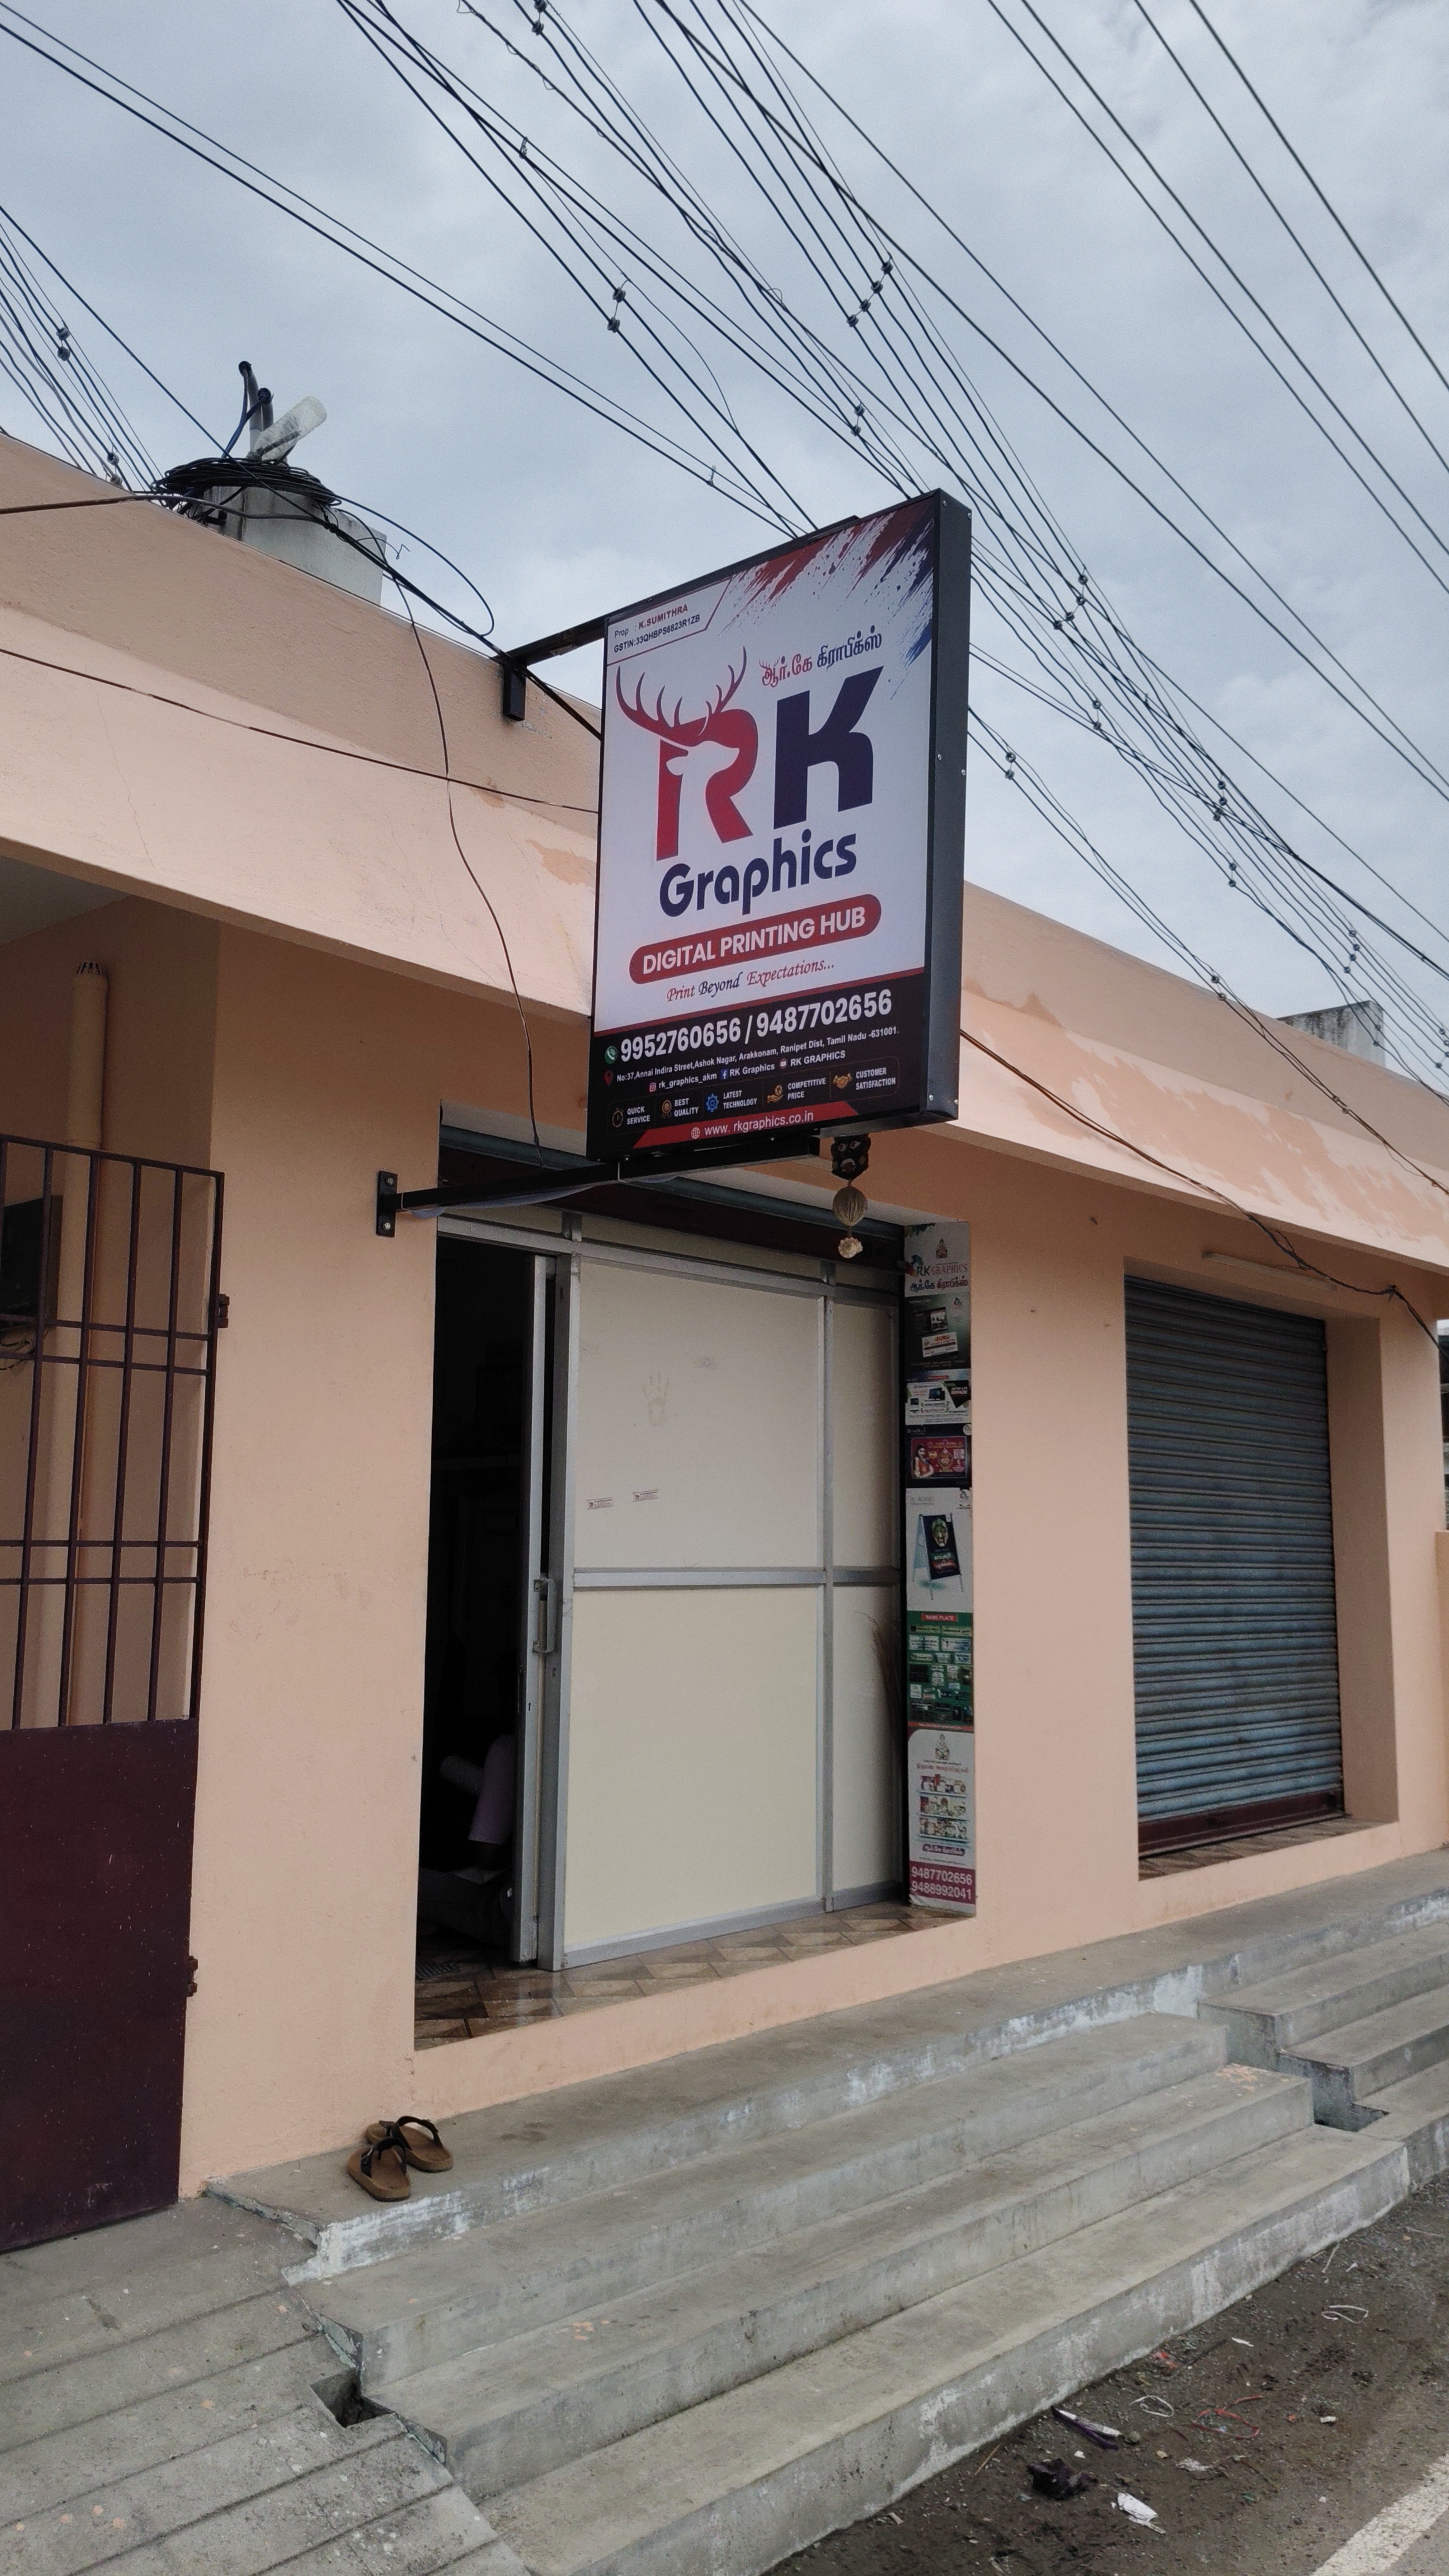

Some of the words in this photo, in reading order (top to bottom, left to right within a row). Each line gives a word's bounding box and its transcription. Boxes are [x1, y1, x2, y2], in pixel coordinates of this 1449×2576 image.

[614, 628, 629, 638] Prop
[638, 604, 688, 630] K.SUMITHRA
[761, 653, 813, 687] ஆர்.கே
[817, 625, 882, 672] கிராபிக்ஸ்
[656, 665, 884, 861] RK
[659, 828, 857, 917] Graphics
[643, 941, 716, 974] DIGITAL
[720, 918, 815, 957] PRINTING
[820, 906, 865, 935] HUB
[667, 984, 695, 1002] Print
[698, 972, 743, 997] Beyond
[747, 959, 835, 987] Expectations...
[621, 1018, 741, 1062] 9952760656
[757, 989, 892, 1037] 9487702656
[617, 1069, 653, 1082] No:37,Annai
[655, 1065, 672, 1075] Indira
[674, 1058, 714, 1072] Street,Ashok
[716, 1055, 737, 1065] Nagar,
[739, 1048, 779, 1061] Arakkonam,
[780, 1041, 807, 1054] Ranipet
[808, 1039, 824, 1049] Dist,
[826, 1035, 845, 1045] Tamil
[848, 1032, 866, 1042] Nadu
[790, 1057, 802, 1067] RK
[804, 1050, 846, 1064] GRAPHICS
[730, 1069, 740, 1077] RK
[742, 1063, 775, 1075] Graphics
[855, 1067, 887, 1079] CUSTOMER
[658, 1072, 717, 1089] rk_graphics_akm
[787, 1077, 826, 1091] COMPETITIVE
[855, 1077, 896, 1091] SATISFACTION
[674, 1098, 689, 1107] BEST
[723, 1090, 742, 1099] LATEST
[787, 1091, 805, 1100] PRICE
[627, 1106, 645, 1116] QUICK
[674, 1106, 699, 1117] QUALITY
[723, 1098, 757, 1109] TECHNOLOGY
[626, 1115, 651, 1125] SERVICE
[733, 1111, 814, 1133] rkgraphics.co.in
[917, 1265, 931, 1277] RK
[931, 1263, 968, 1275] GRAPHICS
[912, 1866, 973, 1885] 9487702656
[913, 1880, 972, 1900] 9488992041
